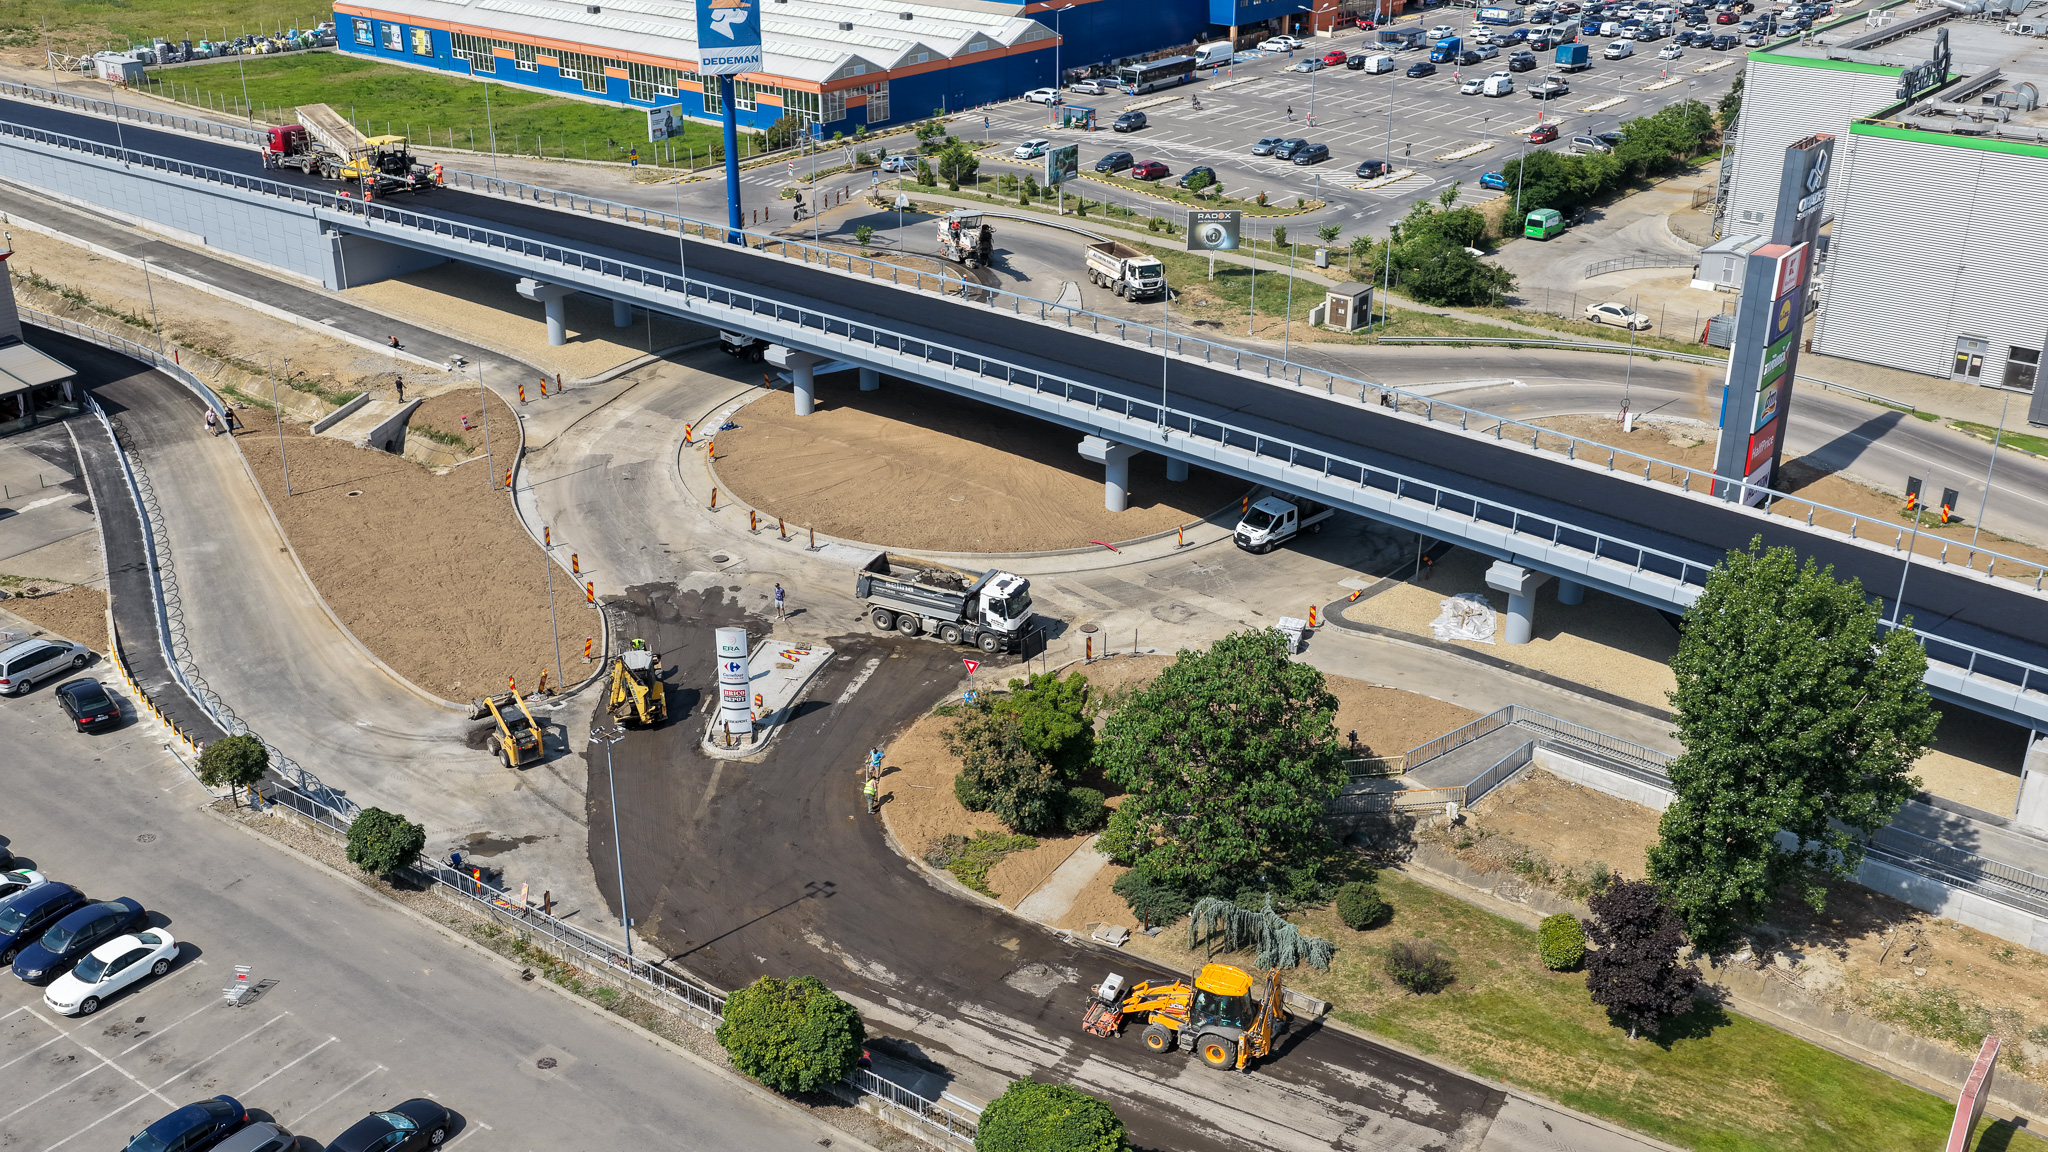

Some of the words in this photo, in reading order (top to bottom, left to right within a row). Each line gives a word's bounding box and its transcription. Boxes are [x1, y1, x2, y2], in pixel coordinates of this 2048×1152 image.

[703, 55, 759, 66] DEDEMAN
[1751, 436, 1774, 459] HalfPrice
[886, 582, 914, 593] selina
